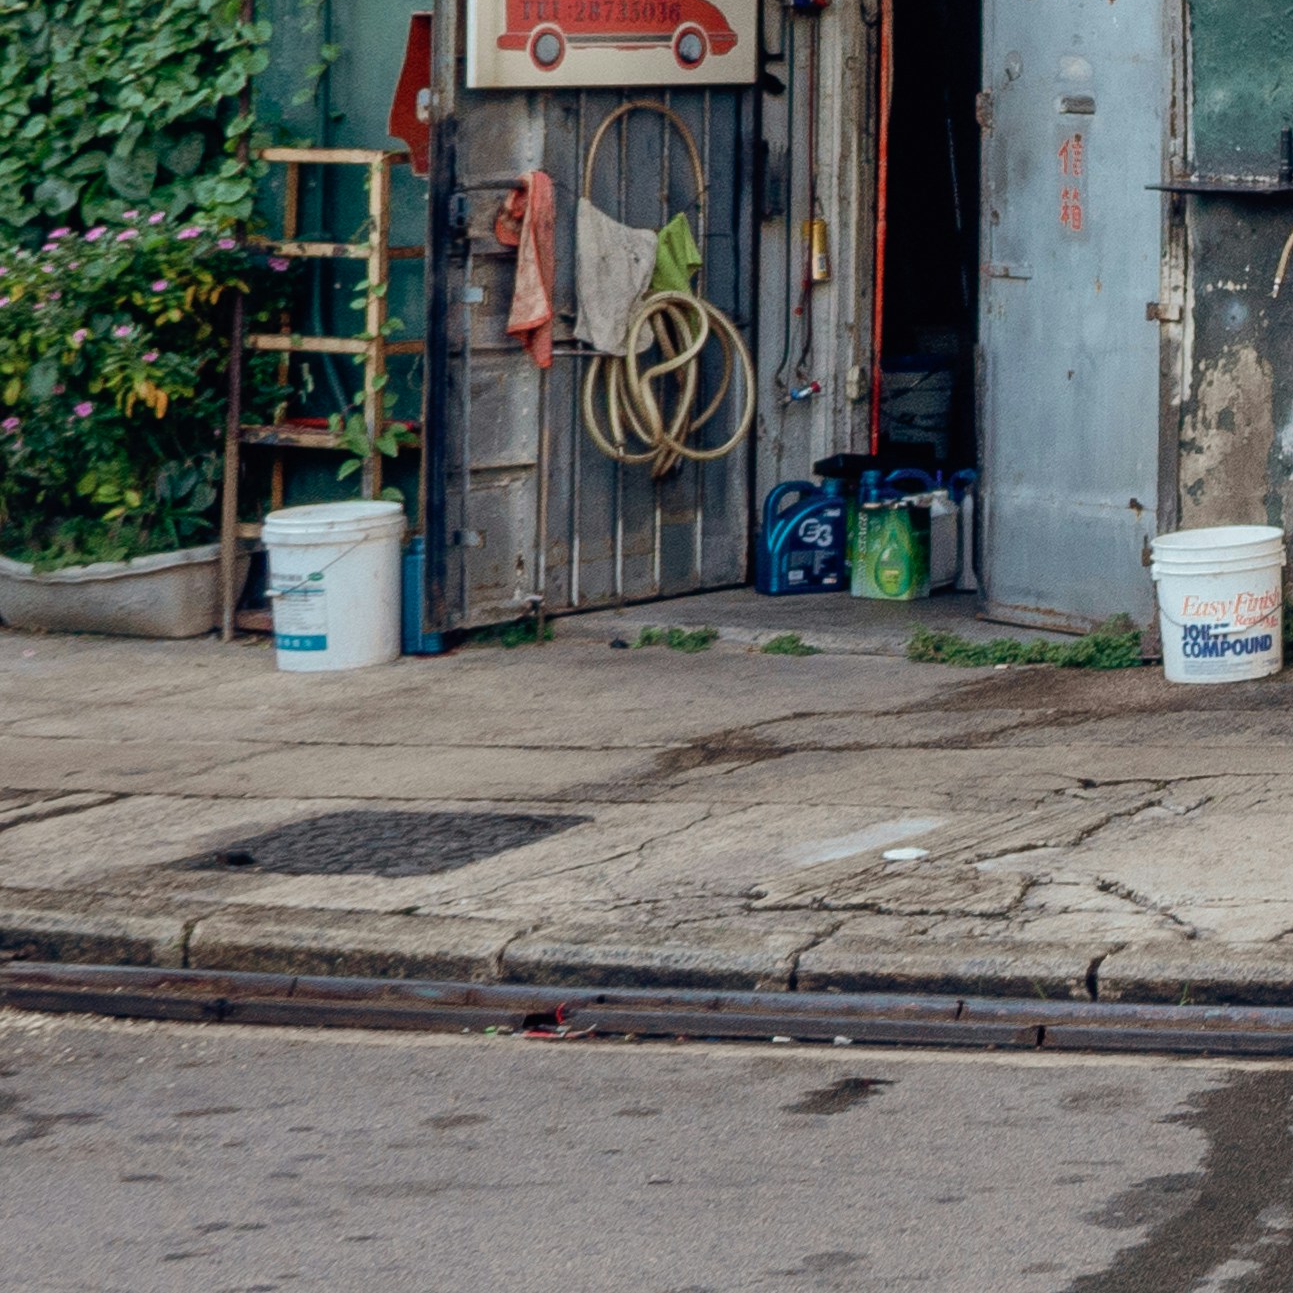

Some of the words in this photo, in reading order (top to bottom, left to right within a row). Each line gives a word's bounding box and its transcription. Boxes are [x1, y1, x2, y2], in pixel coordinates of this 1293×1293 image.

[1057, 135, 1083, 231] 信箱
[1180, 594, 1228, 622] Easy
[1182, 634, 1273, 658] COMPOUND
